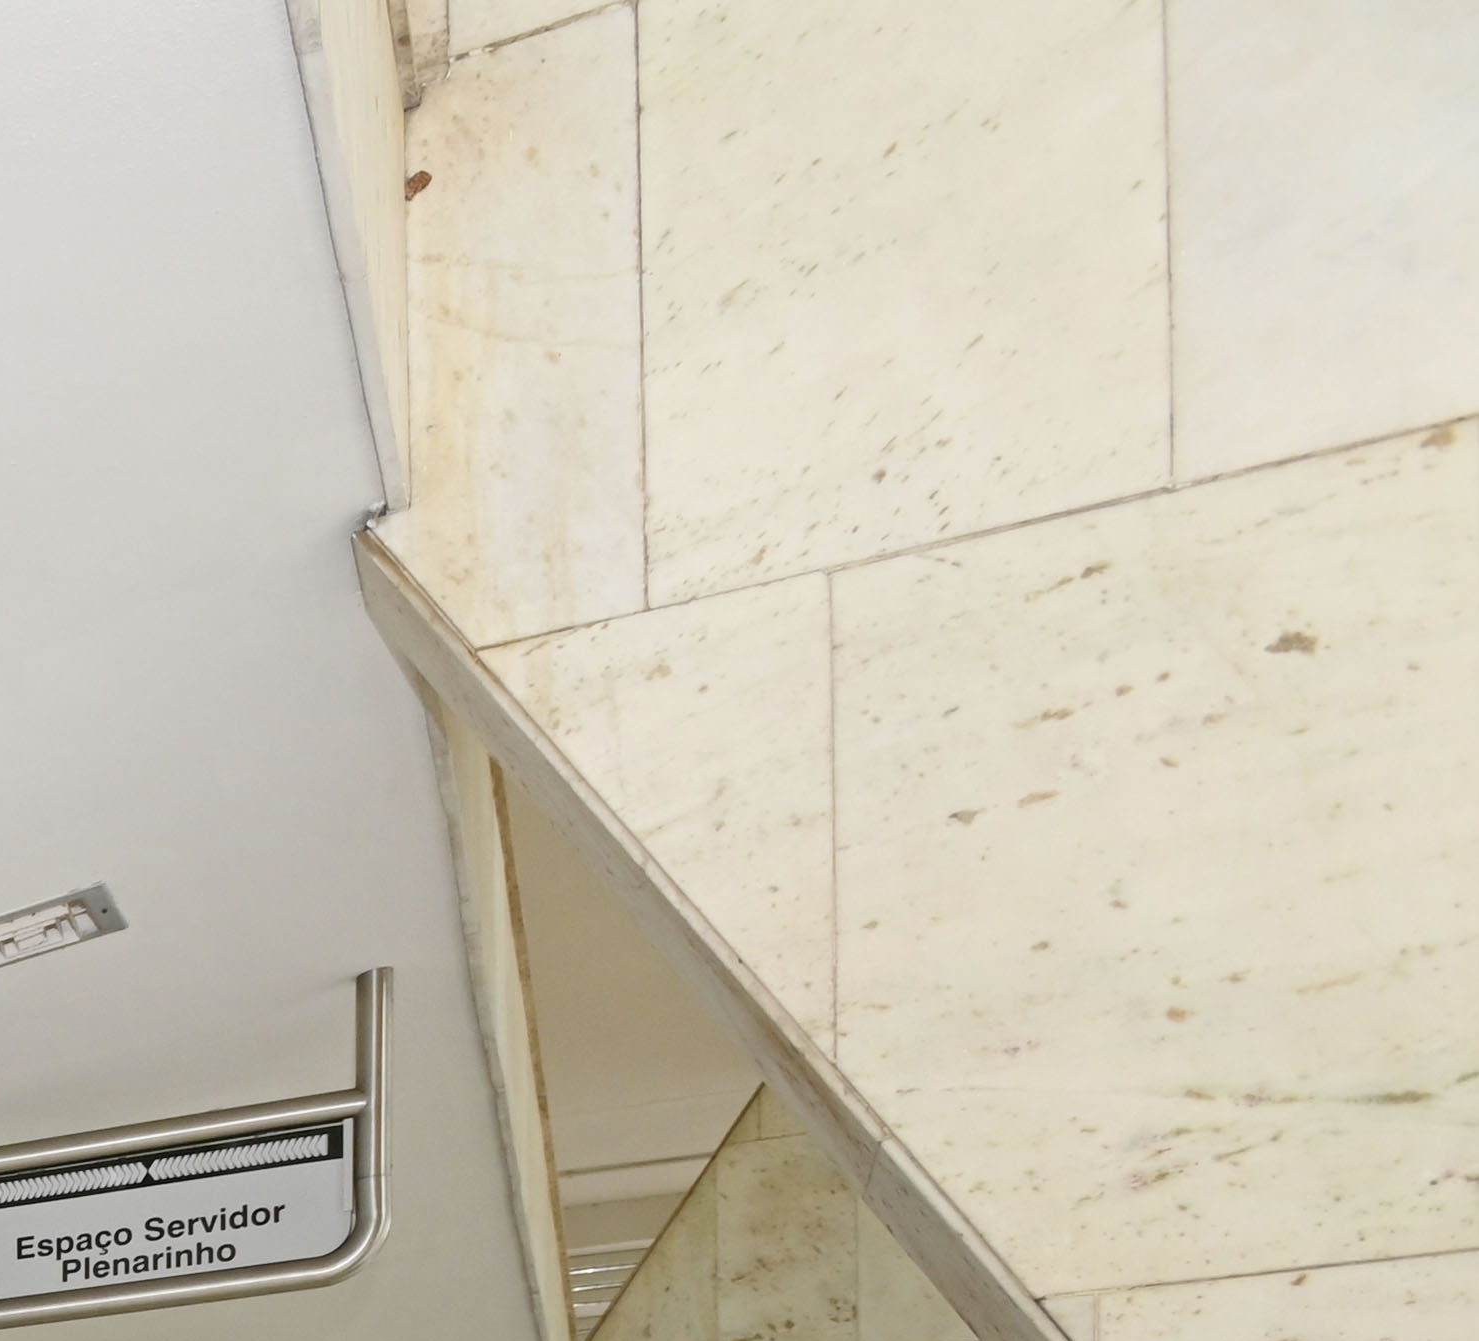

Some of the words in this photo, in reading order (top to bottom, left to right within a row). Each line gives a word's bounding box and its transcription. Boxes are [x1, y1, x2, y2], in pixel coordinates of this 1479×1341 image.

[15, 1226, 133, 1260] Espaço
[143, 1201, 285, 1242] Servidor
[61, 1241, 237, 1283] Plenarinho
